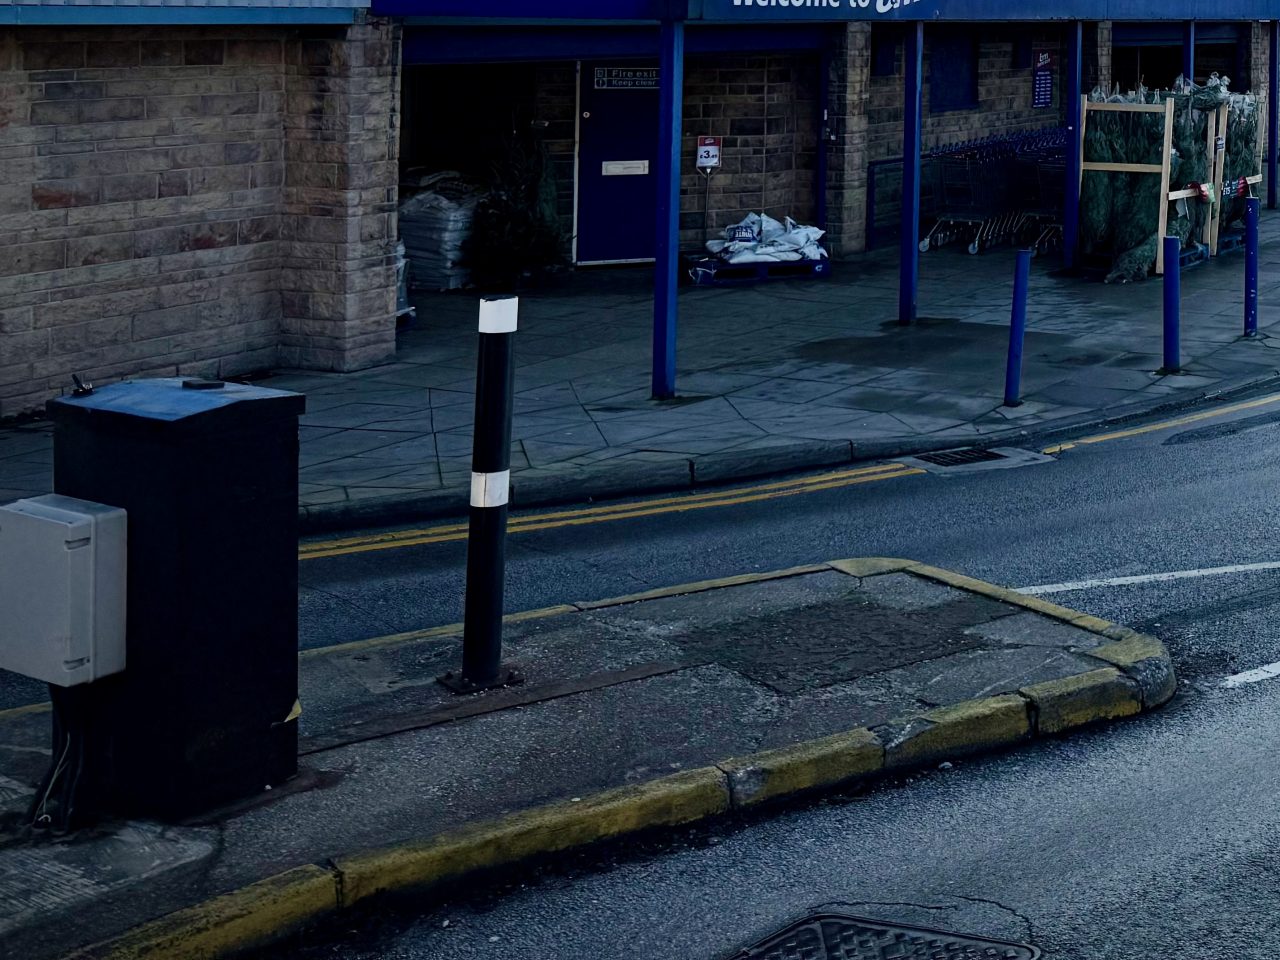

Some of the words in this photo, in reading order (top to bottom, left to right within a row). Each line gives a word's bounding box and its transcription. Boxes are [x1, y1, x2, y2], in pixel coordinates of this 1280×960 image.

[612, 69, 633, 78] Fire
[636, 69, 657, 78] exit
[612, 79, 633, 87] Keep
